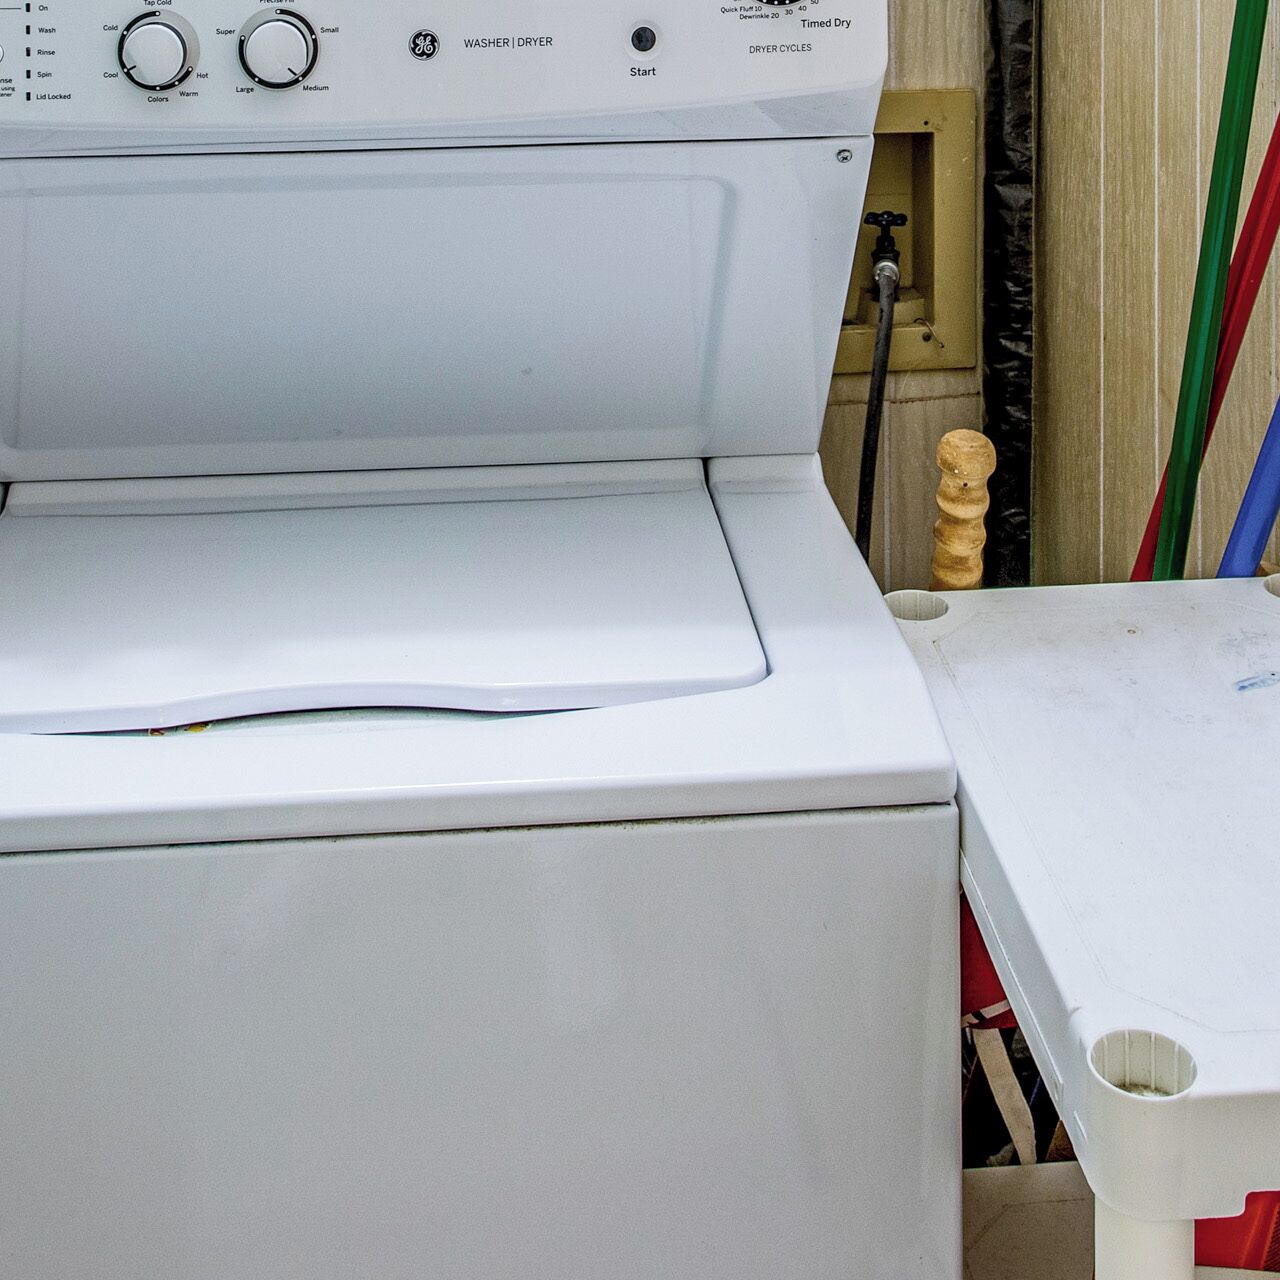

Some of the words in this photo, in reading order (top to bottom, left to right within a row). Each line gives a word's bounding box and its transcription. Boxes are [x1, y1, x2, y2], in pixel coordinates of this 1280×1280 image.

[800, 19, 832, 28] Timed
[834, 18, 851, 28] Dry
[464, 38, 510, 48] WASHER
[517, 37, 553, 47] DRYER
[749, 45, 777, 54] DRYER
[779, 44, 812, 52] CYCLES
[630, 67, 656, 77] Start
